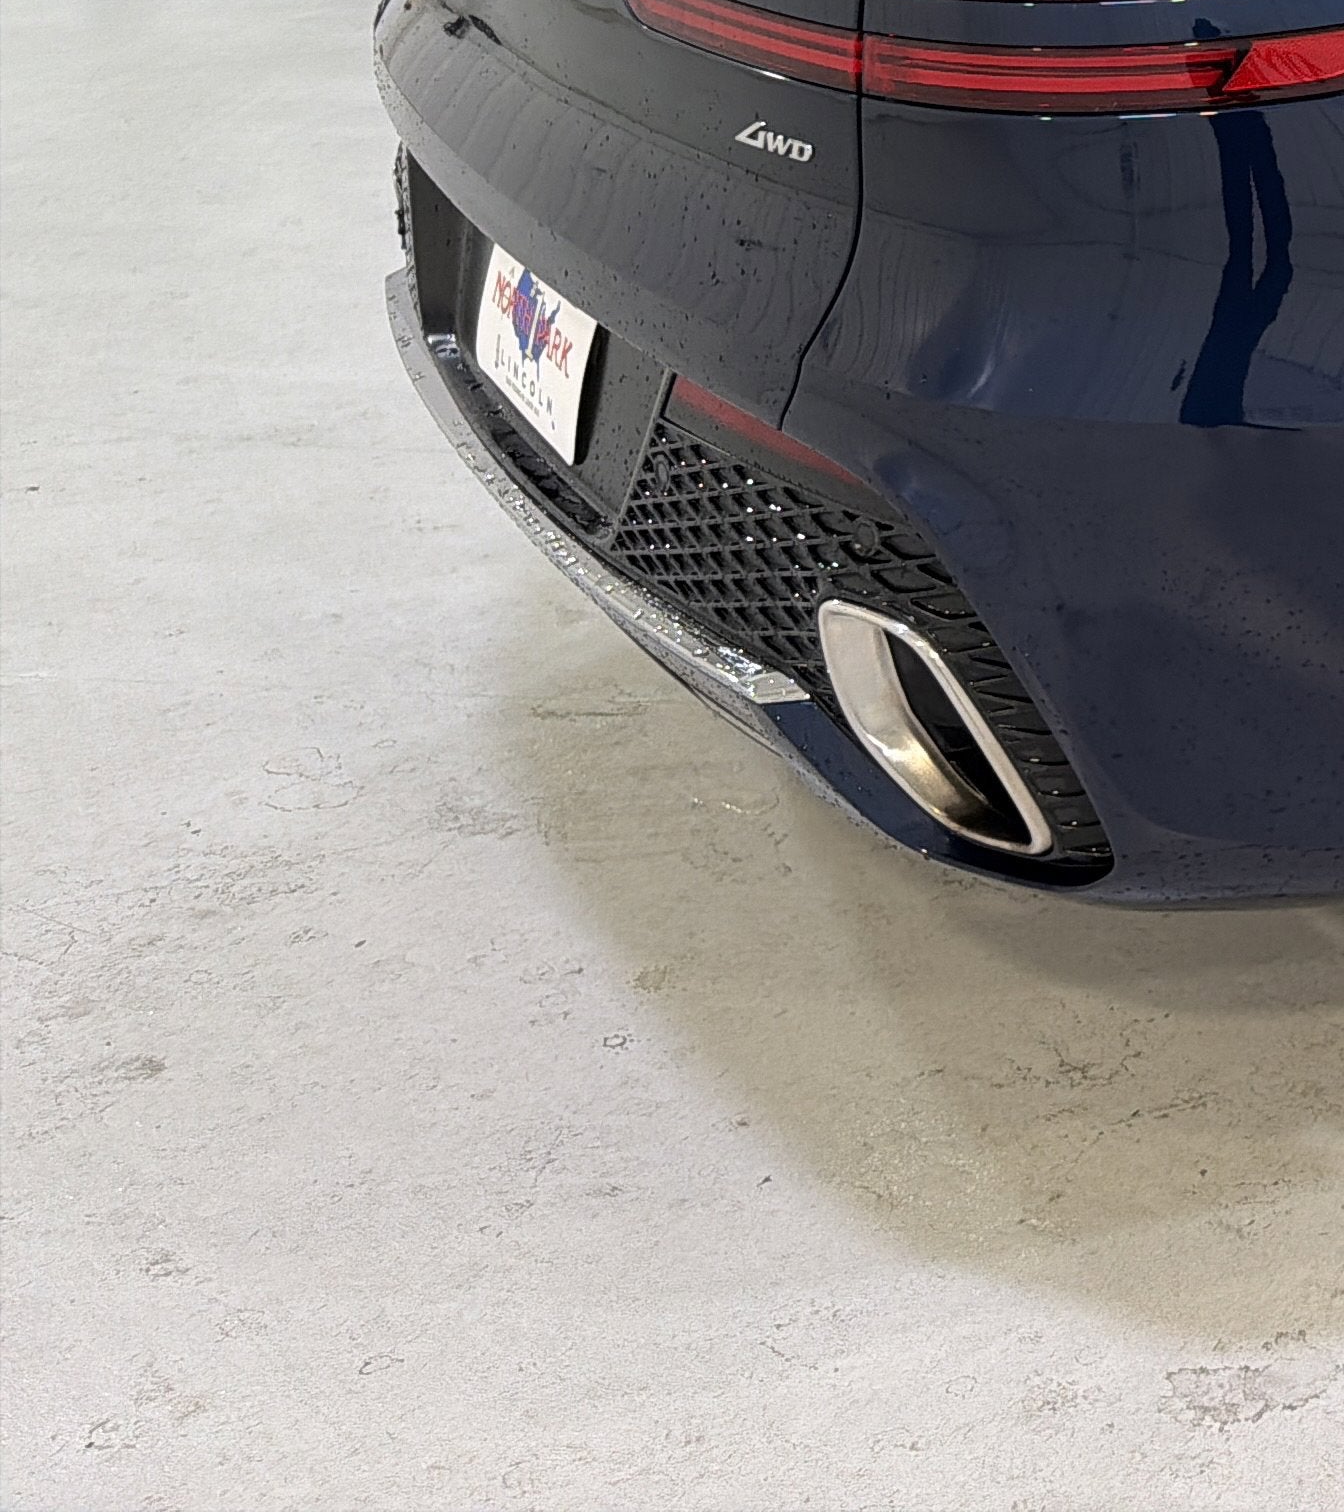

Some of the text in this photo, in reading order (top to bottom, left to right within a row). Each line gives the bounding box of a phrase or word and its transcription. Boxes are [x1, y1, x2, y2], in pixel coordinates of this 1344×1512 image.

[492, 271, 533, 336] NORTH
[534, 313, 574, 379] PARK
[500, 353, 553, 417] LINCOLN
